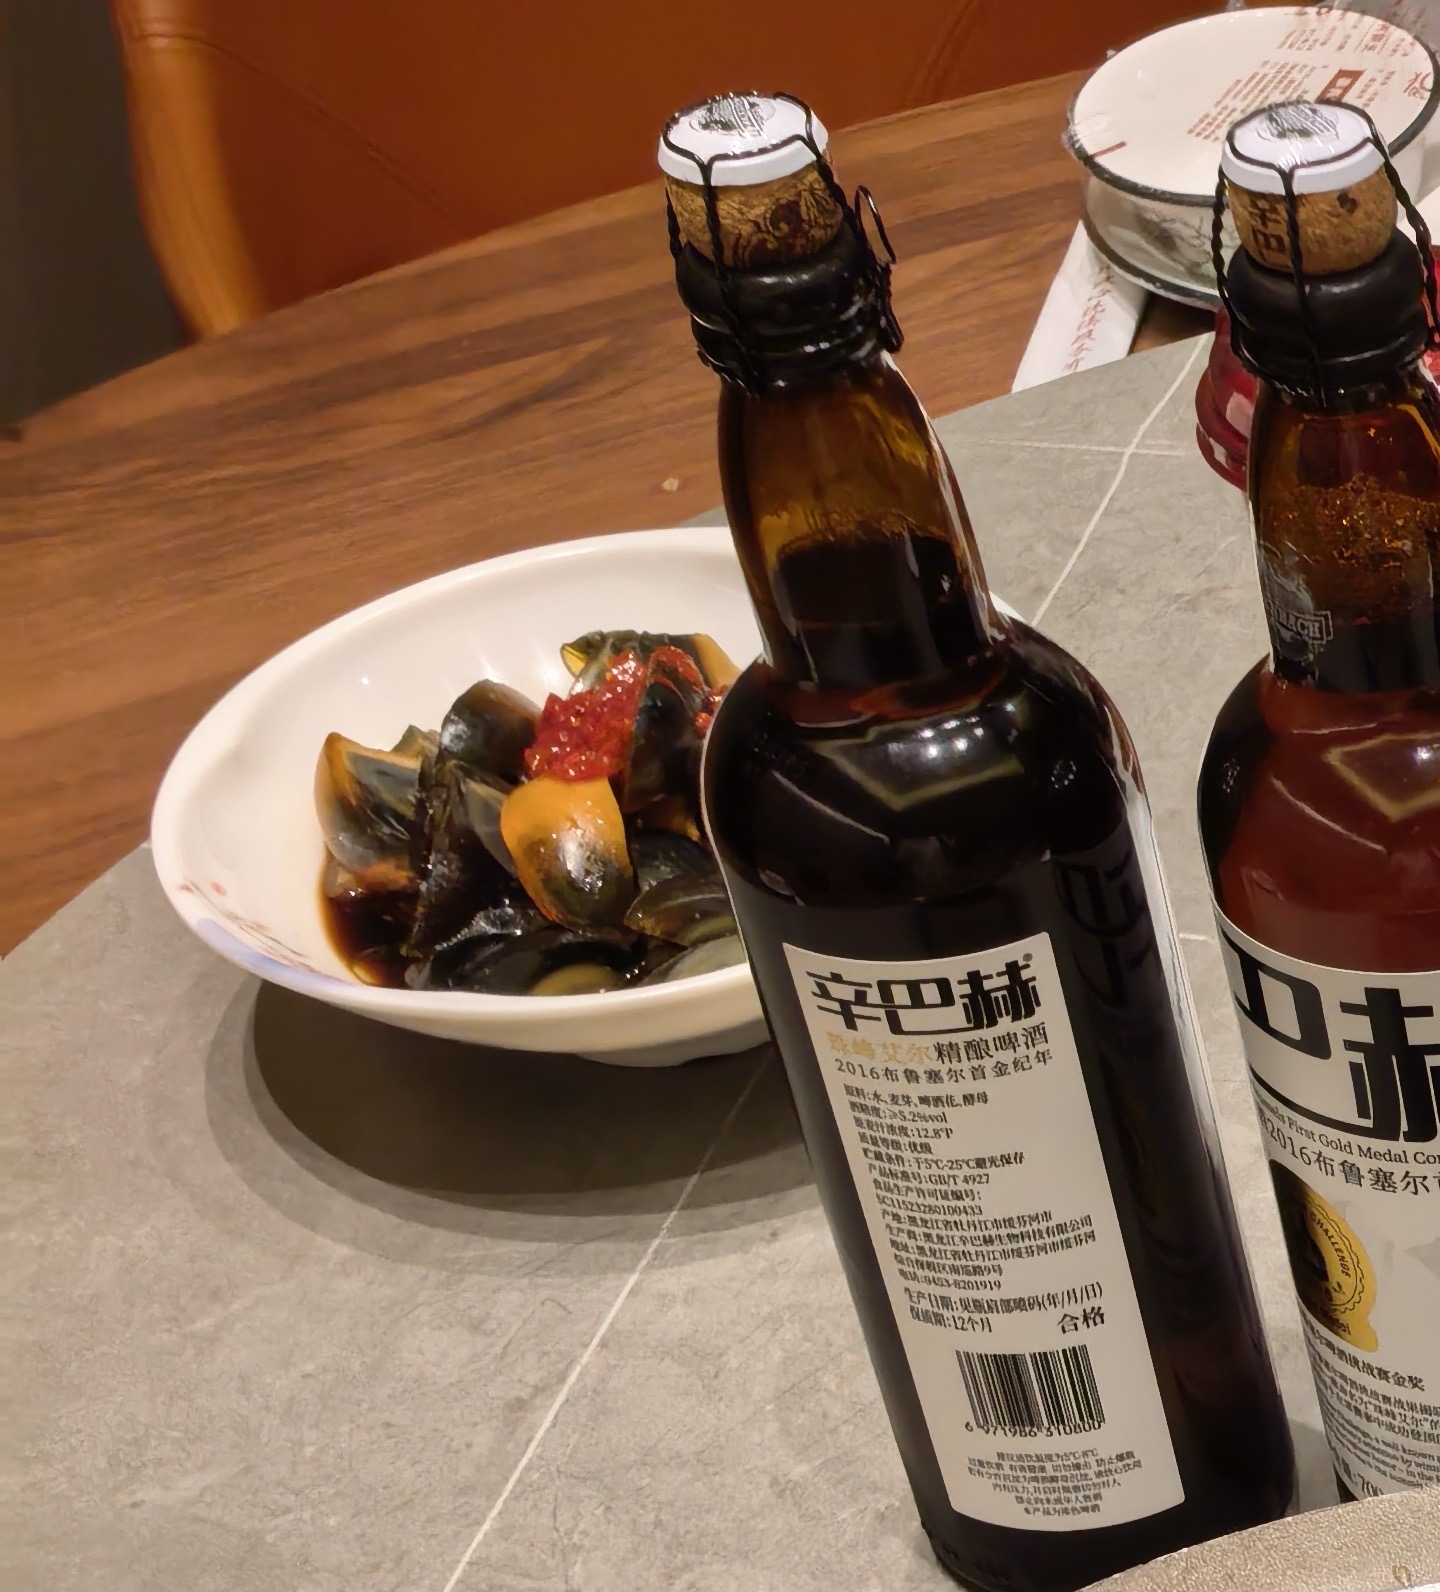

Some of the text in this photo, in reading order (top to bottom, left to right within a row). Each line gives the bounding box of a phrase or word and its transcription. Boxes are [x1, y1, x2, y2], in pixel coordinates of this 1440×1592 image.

[806, 960, 1042, 1036] 辛巴赫
[1319, 1133, 1354, 1155] Gold
[1357, 1143, 1408, 1164] Medal
[1057, 1306, 1105, 1334] 合格
